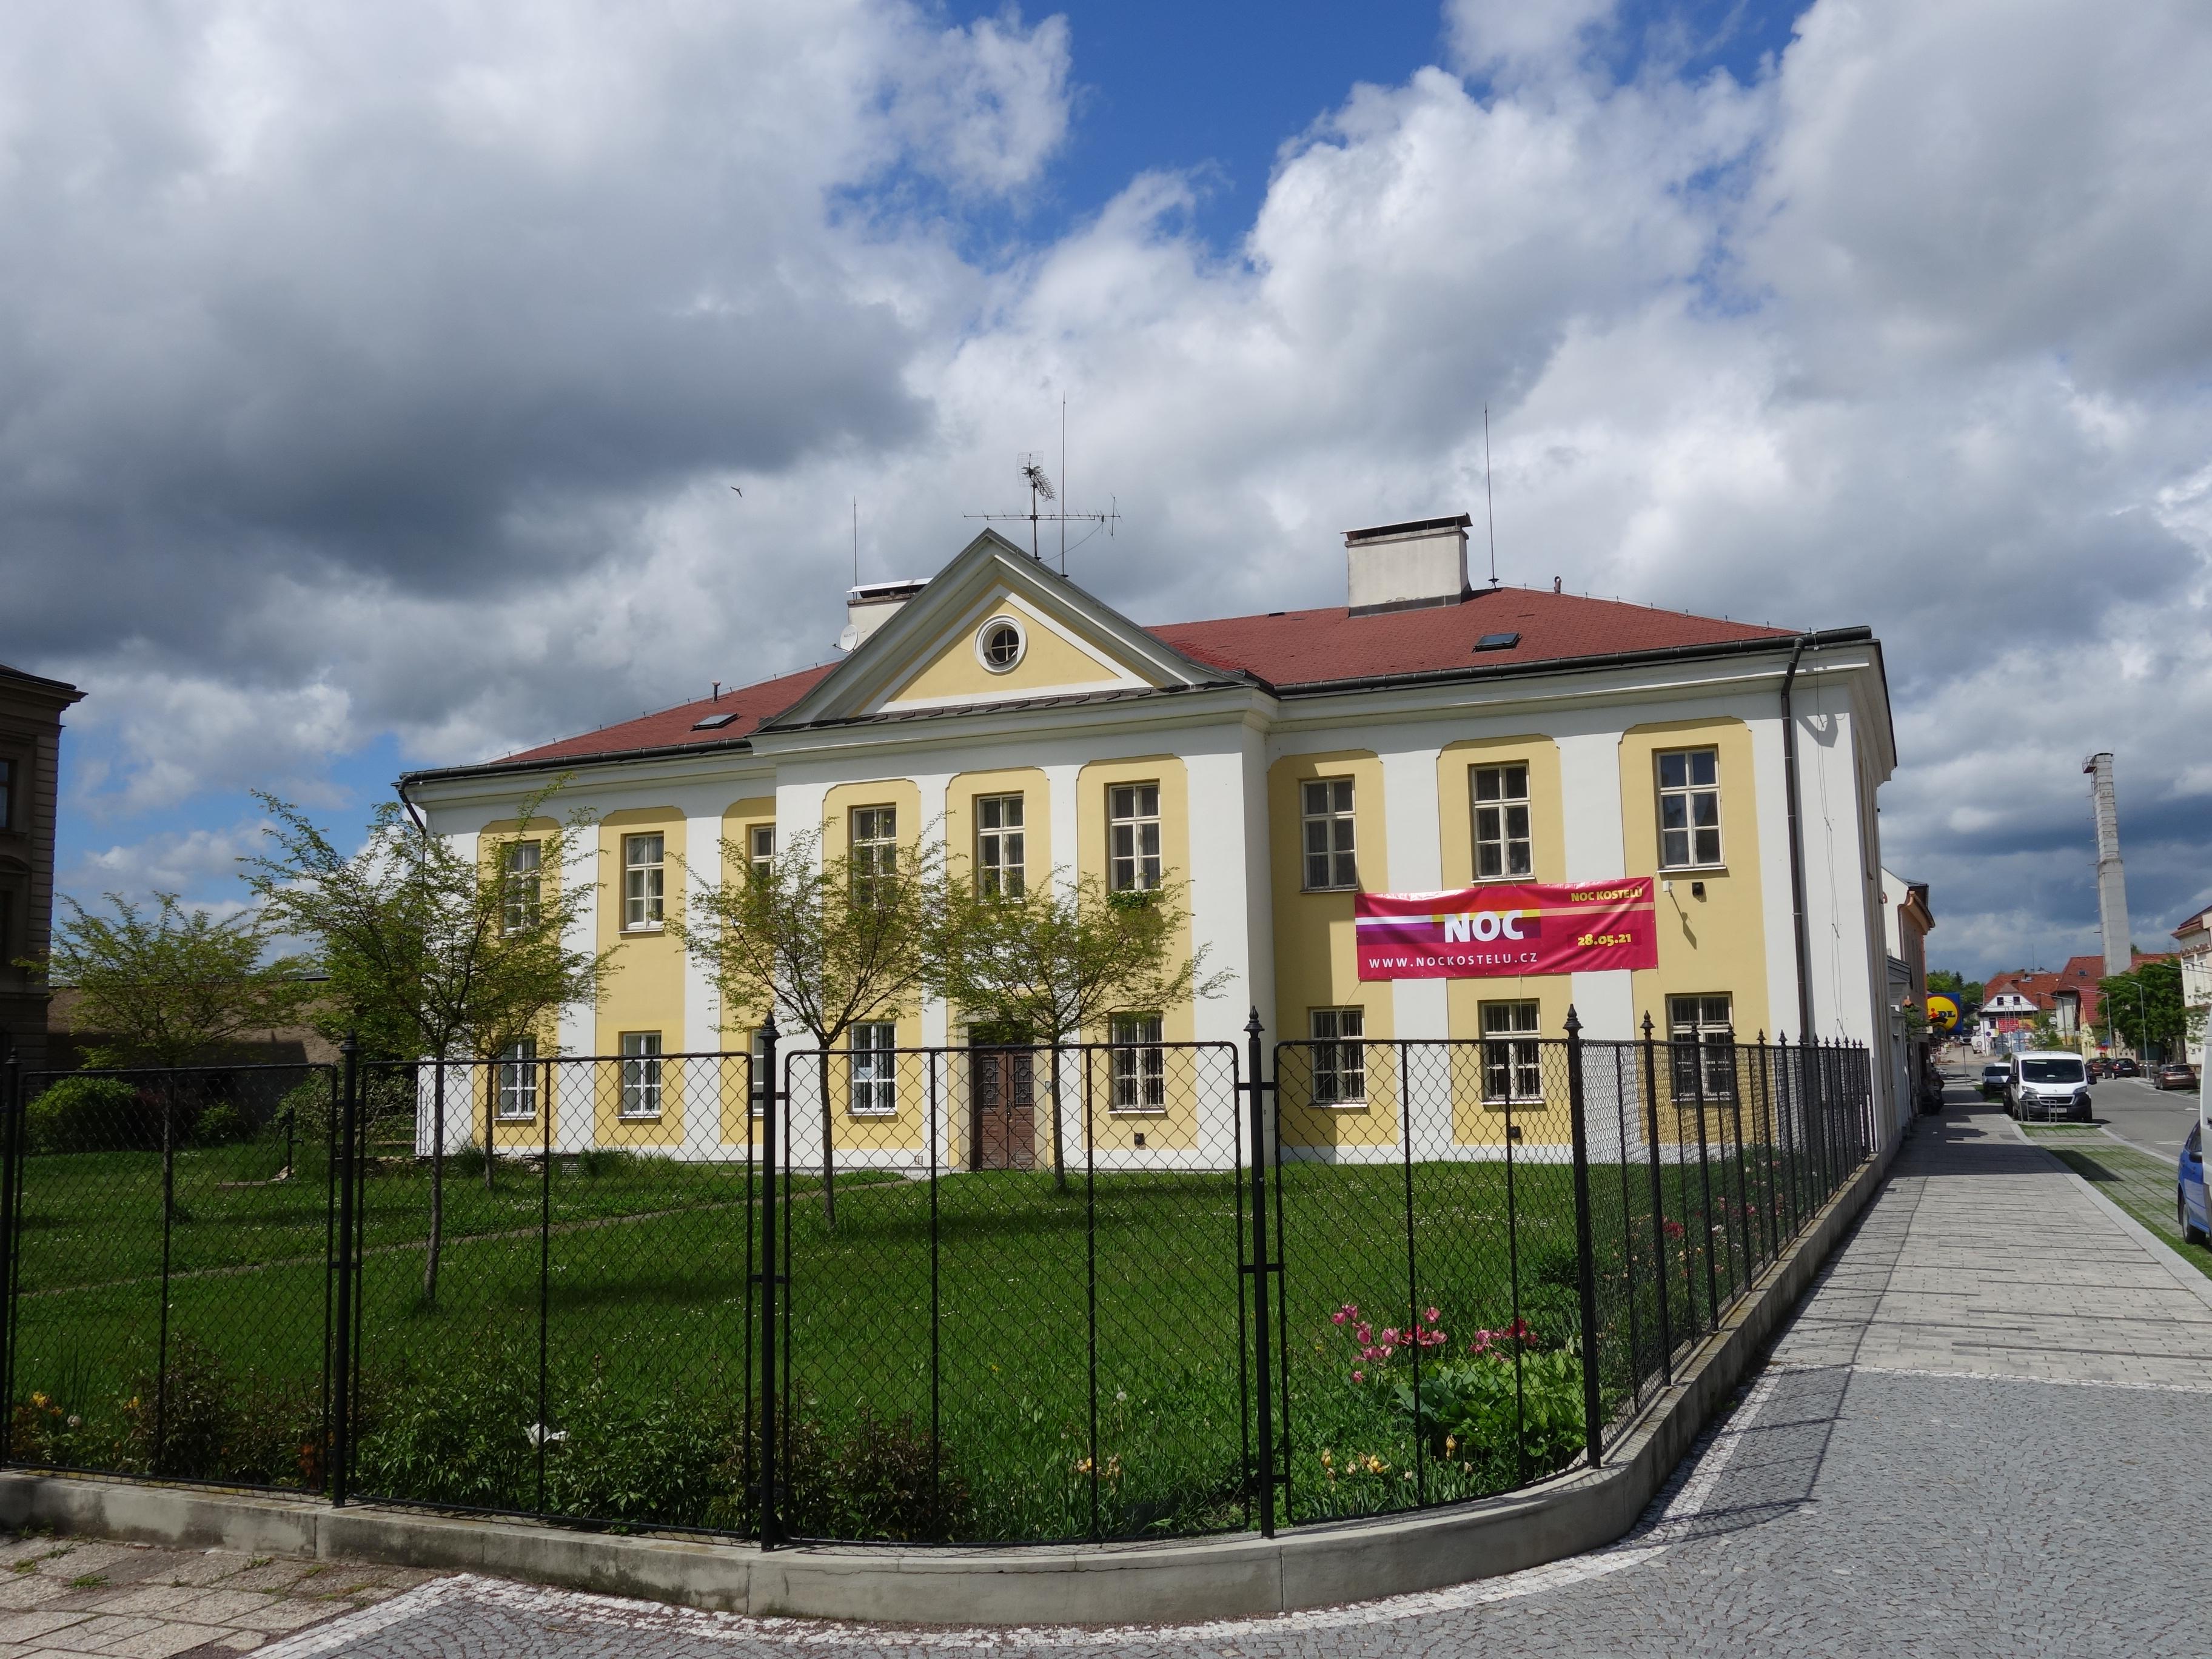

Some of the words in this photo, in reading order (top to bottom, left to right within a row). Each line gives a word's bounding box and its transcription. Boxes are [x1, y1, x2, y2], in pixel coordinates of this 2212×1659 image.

[1571, 892, 1595, 902] NOC
[1596, 886, 1643, 900] KOSTELŮ
[1444, 910, 1524, 943] NOC
[1578, 934, 1632, 947] 28.05.21
[1369, 953, 1537, 968] WWW.NOCKOSTELU.CZ
